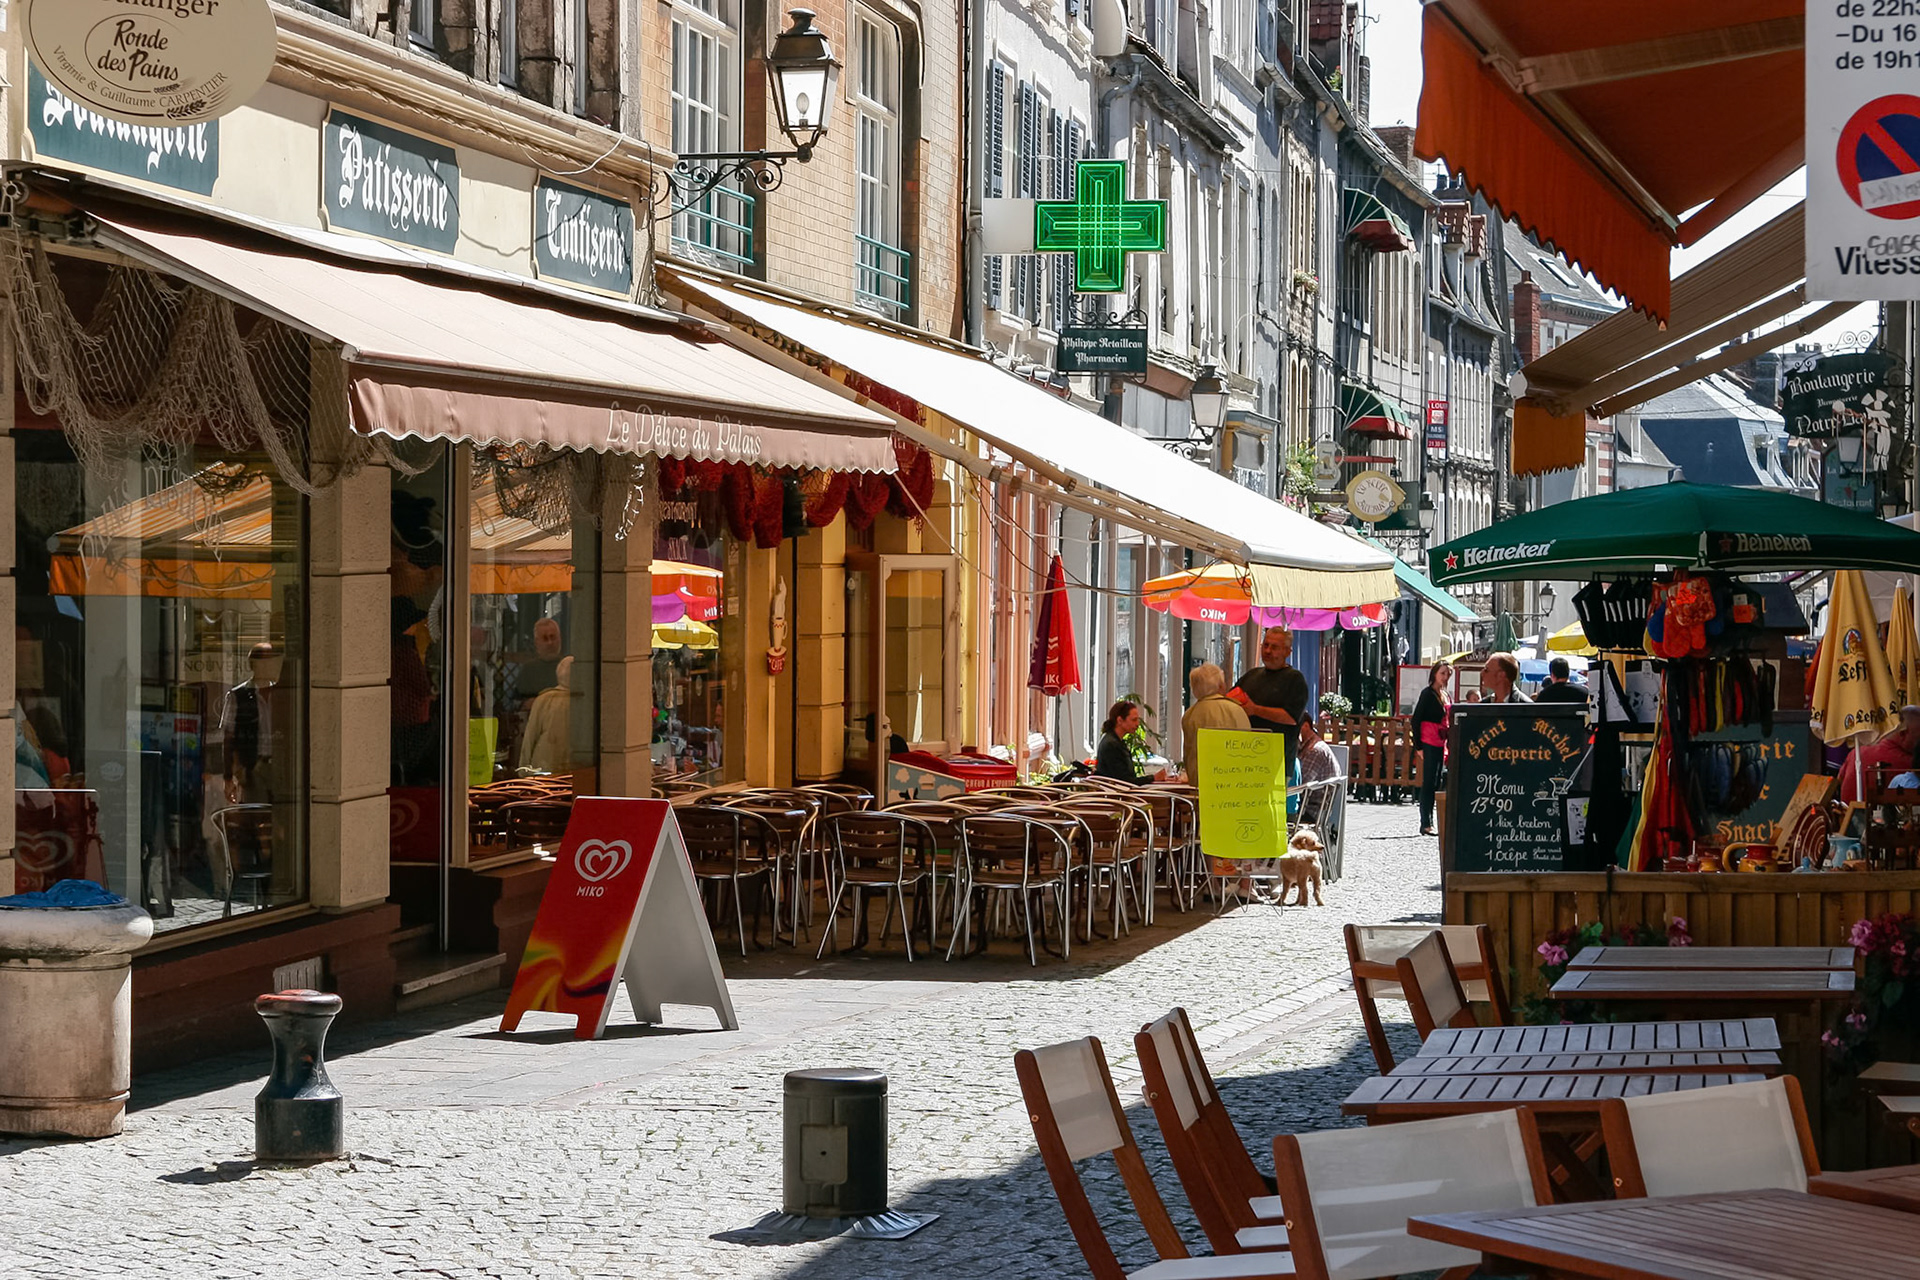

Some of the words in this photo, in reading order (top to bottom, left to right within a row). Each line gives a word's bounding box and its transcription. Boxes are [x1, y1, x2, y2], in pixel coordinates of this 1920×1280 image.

[1836, 0, 1864, 17] de
[113, 19, 168, 52] Ronde
[1893, 24, 1917, 42] 16
[97, 50, 126, 72] des
[128, 49, 179, 81] Pains
[1836, 51, 1864, 69] de
[53, 45, 87, 84] Virginie
[88, 80, 99, 92] &
[100, 84, 156, 108] Guillaume
[159, 72, 228, 108] CARPENTIER
[339, 123, 448, 232] Patisserie
[545, 188, 626, 277] Confiserie
[1061, 337, 1097, 350] Philippe
[1099, 338, 1143, 348] Retailleau
[1075, 352, 1128, 366] Pharmacien
[606, 401, 630, 443] Le
[635, 404, 687, 448] Délice
[692, 415, 710, 450] du
[715, 414, 762, 455] Palais
[1735, 533, 1812, 552] Heineken
[1463, 541, 1552, 567] Heineken
[1469, 720, 1507, 759] Saint
[1532, 719, 1581, 763] Michel
[1488, 746, 1552, 766] Crêperie
[1476, 774, 1525, 795] Menu
[1516, 814, 1552, 828] breton
[1495, 828, 1533, 849] galette
[1534, 834, 1549, 843] au
[576, 885, 605, 897] MIKO
